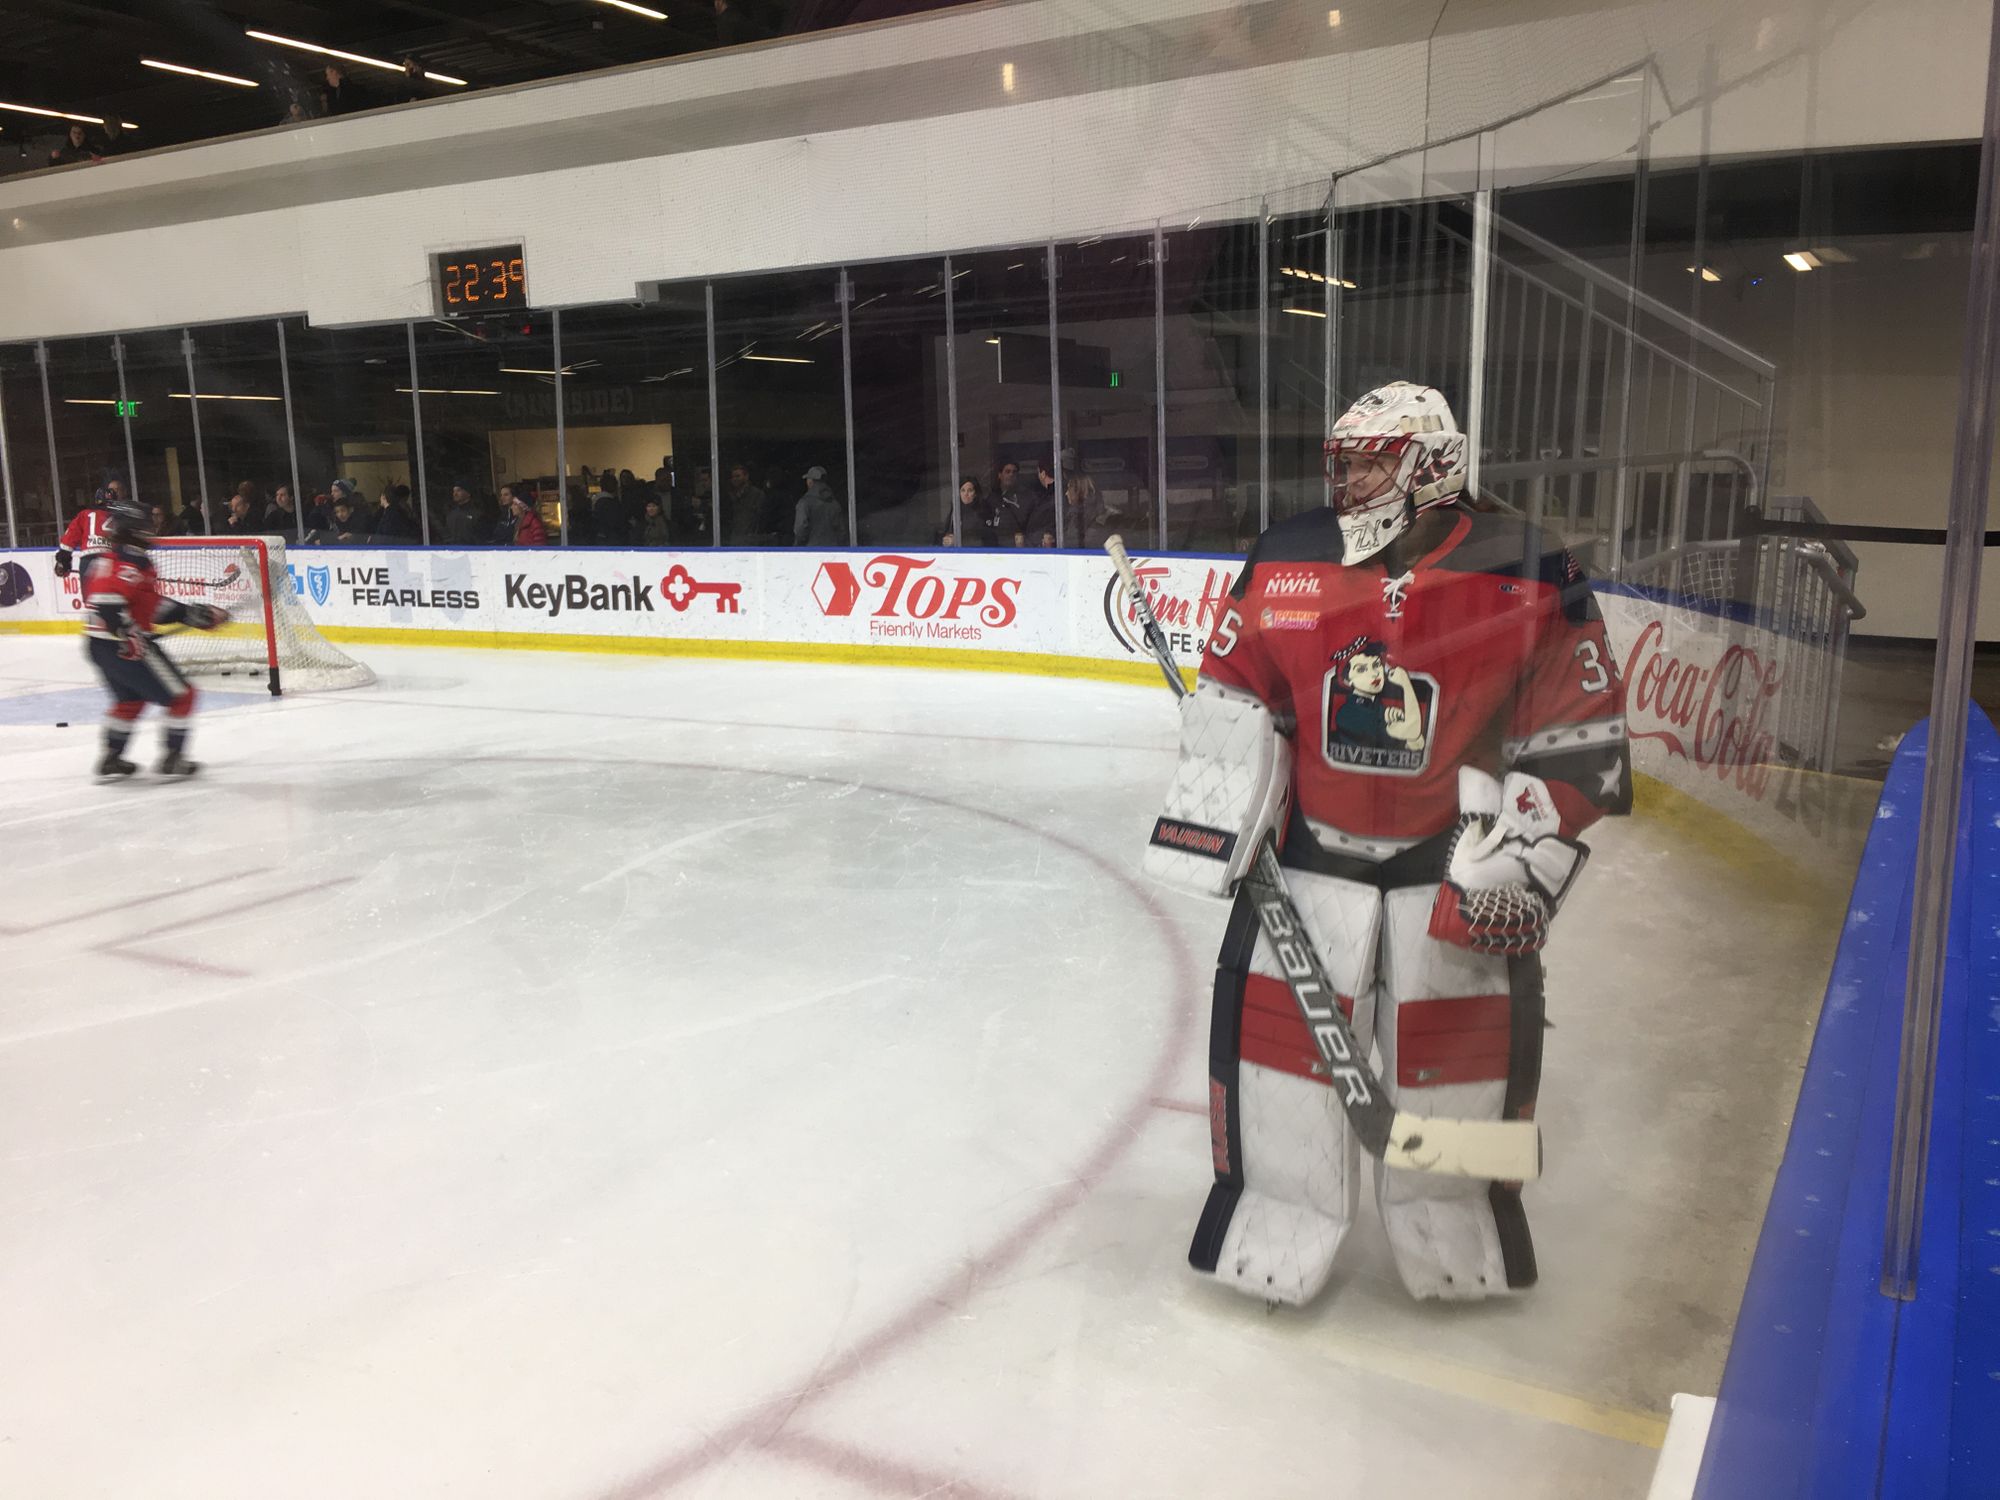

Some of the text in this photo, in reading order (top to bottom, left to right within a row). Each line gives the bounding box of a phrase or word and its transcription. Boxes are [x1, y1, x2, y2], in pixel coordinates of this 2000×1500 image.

[446, 259, 526, 303] 22:39
[118, 401, 136, 416] EIT
[177, 577, 206, 596] CLOSE
[337, 567, 390, 586] LIVE
[1264, 577, 1322, 593] NWHL
[352, 588, 480, 609] FEARLESS
[504, 573, 655, 617] KeyBank
[863, 555, 1022, 628] TOPS
[1127, 567, 1192, 627] Tim
[870, 620, 982, 640] Friendly Markets
[1210, 606, 1244, 659] 5
[1143, 632, 1192, 653] CFE
[1328, 741, 1422, 769] RIVETERS
[1260, 901, 1373, 1107] BAUER
